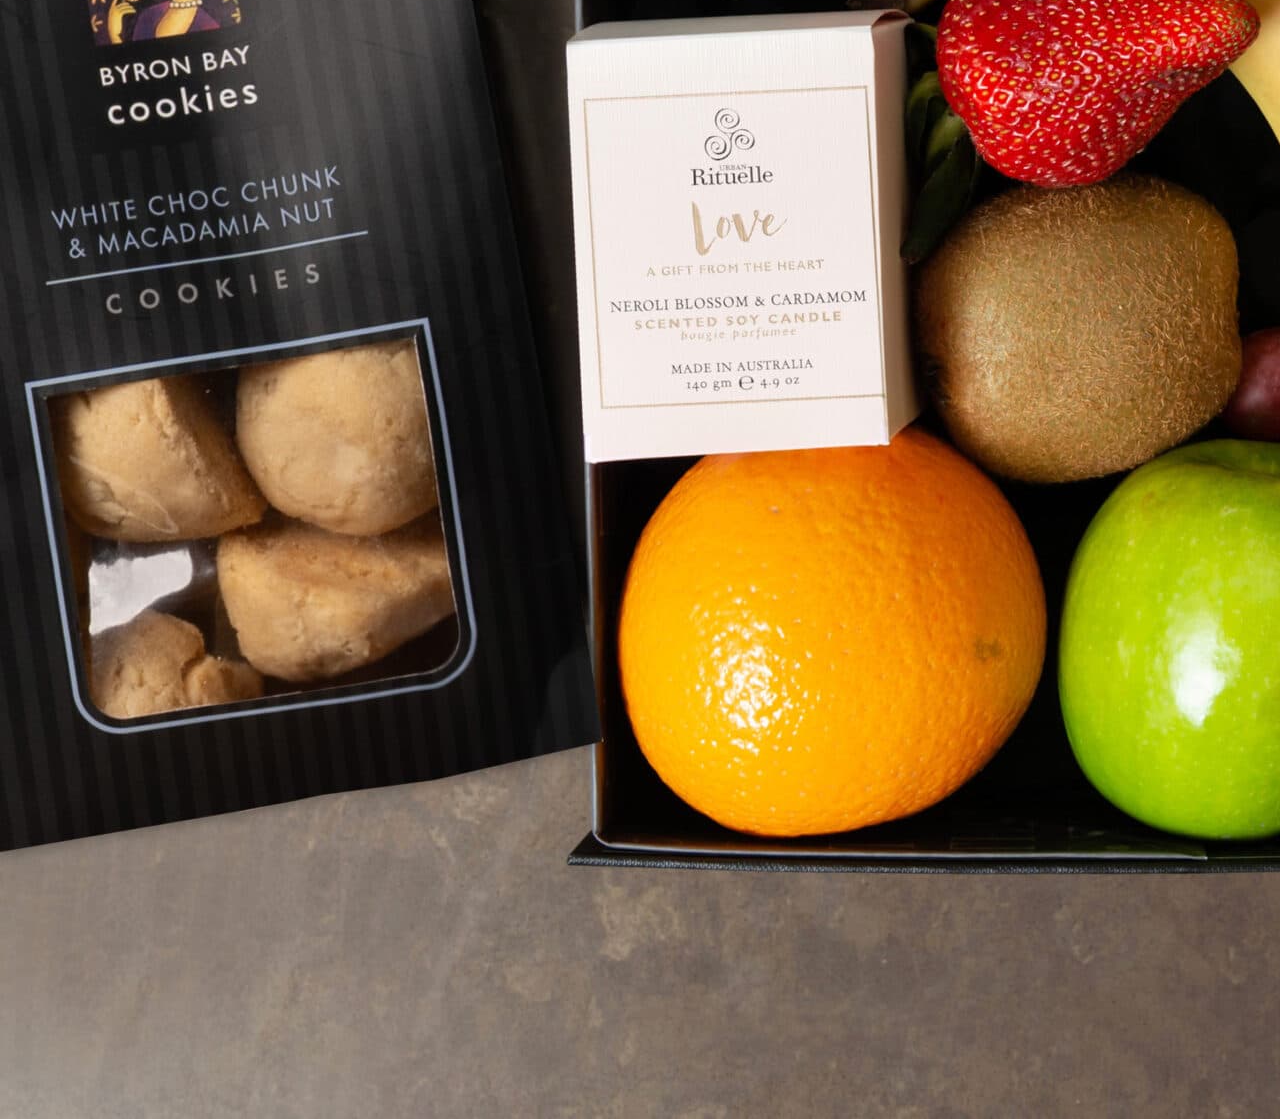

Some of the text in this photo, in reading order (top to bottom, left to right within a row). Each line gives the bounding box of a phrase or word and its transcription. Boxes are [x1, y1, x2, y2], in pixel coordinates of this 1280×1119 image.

[99, 45, 250, 87] BYRON BAY
[107, 84, 258, 125] cookies
[690, 165, 774, 187] Rituelle
[51, 166, 341, 230] WHITE CHOC CHUNK
[69, 198, 335, 260] & MACADAMIA NUT
[646, 258, 826, 277] A GIFT FROM THE HEART
[105, 263, 321, 315] COOKIES
[610, 289, 868, 314] NEROLI BLOSSOM & CARDAMOM
[634, 310, 842, 330] SCENTED SOY CANDLE
[671, 358, 814, 375] MADE IN AUSTRALIA
[713, 378, 732, 392] gm
[760, 377, 780, 389] 4.9
[785, 375, 800, 386] oz
